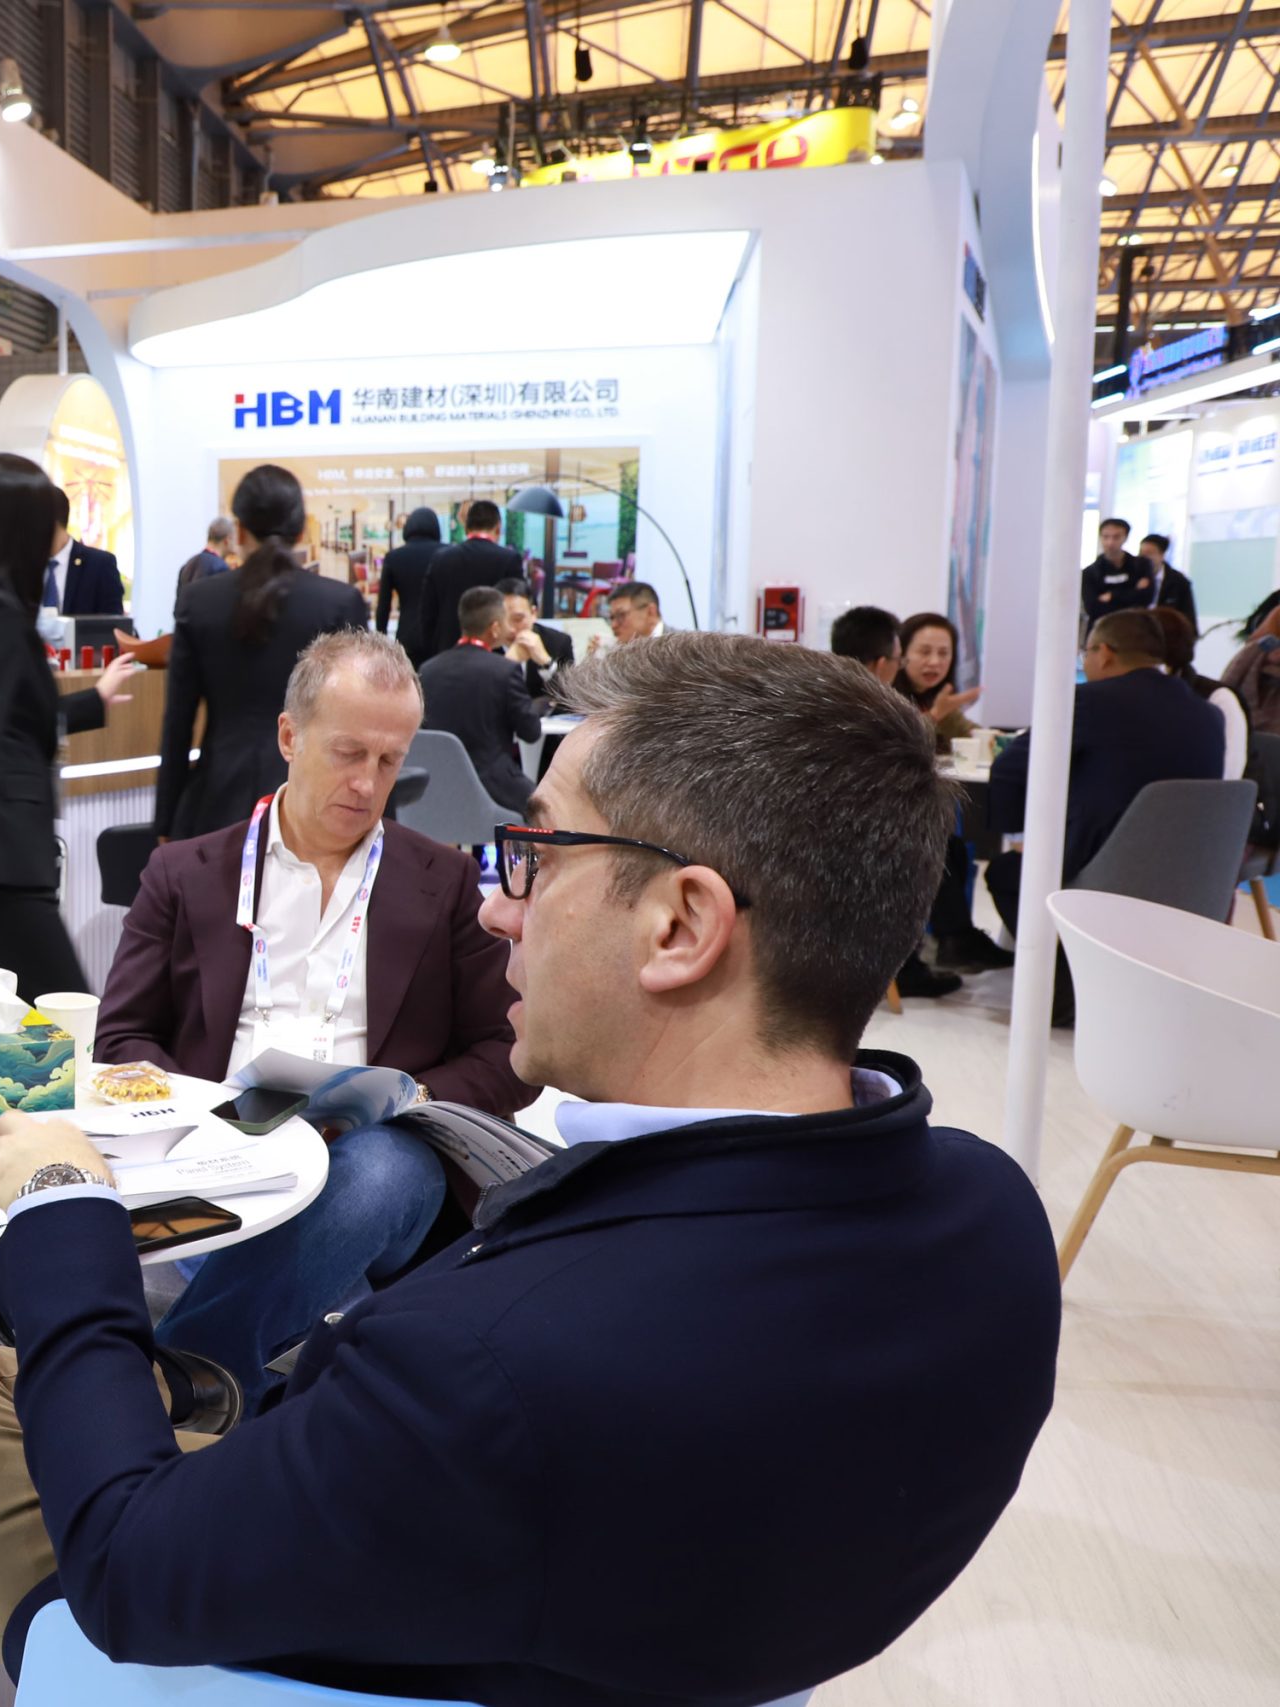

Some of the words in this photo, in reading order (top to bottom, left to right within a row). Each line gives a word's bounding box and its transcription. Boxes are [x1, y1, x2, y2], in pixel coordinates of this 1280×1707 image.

[234, 389, 341, 429] HBM
[351, 378, 619, 411] 华南建材(深圳)有限公司
